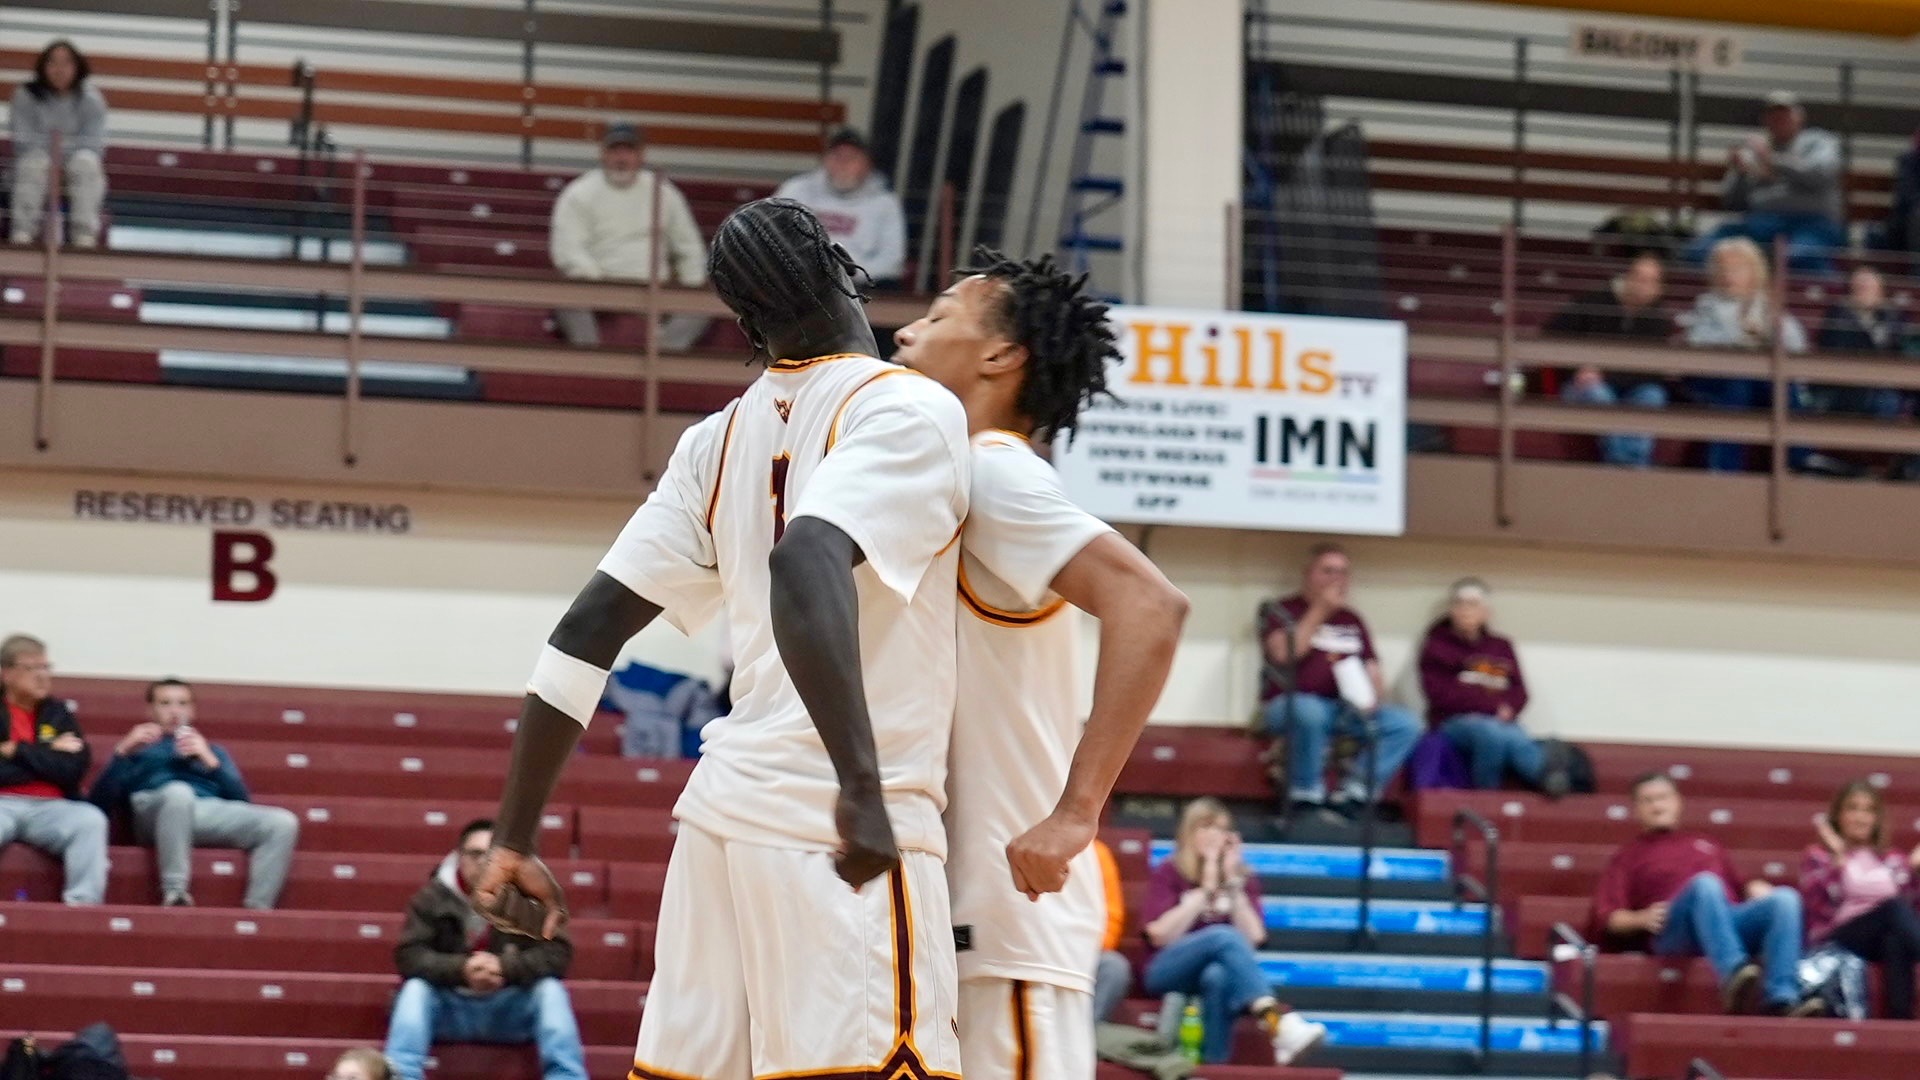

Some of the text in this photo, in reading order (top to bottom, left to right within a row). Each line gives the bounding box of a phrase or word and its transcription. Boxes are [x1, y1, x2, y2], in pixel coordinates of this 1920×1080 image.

[1579, 30, 1698, 61] BALCONY
[1128, 321, 1335, 395] Hills
[1256, 415, 1375, 468] IMN
[74, 490, 411, 533] RESERVED SEATING
[212, 529, 277, 603] B
